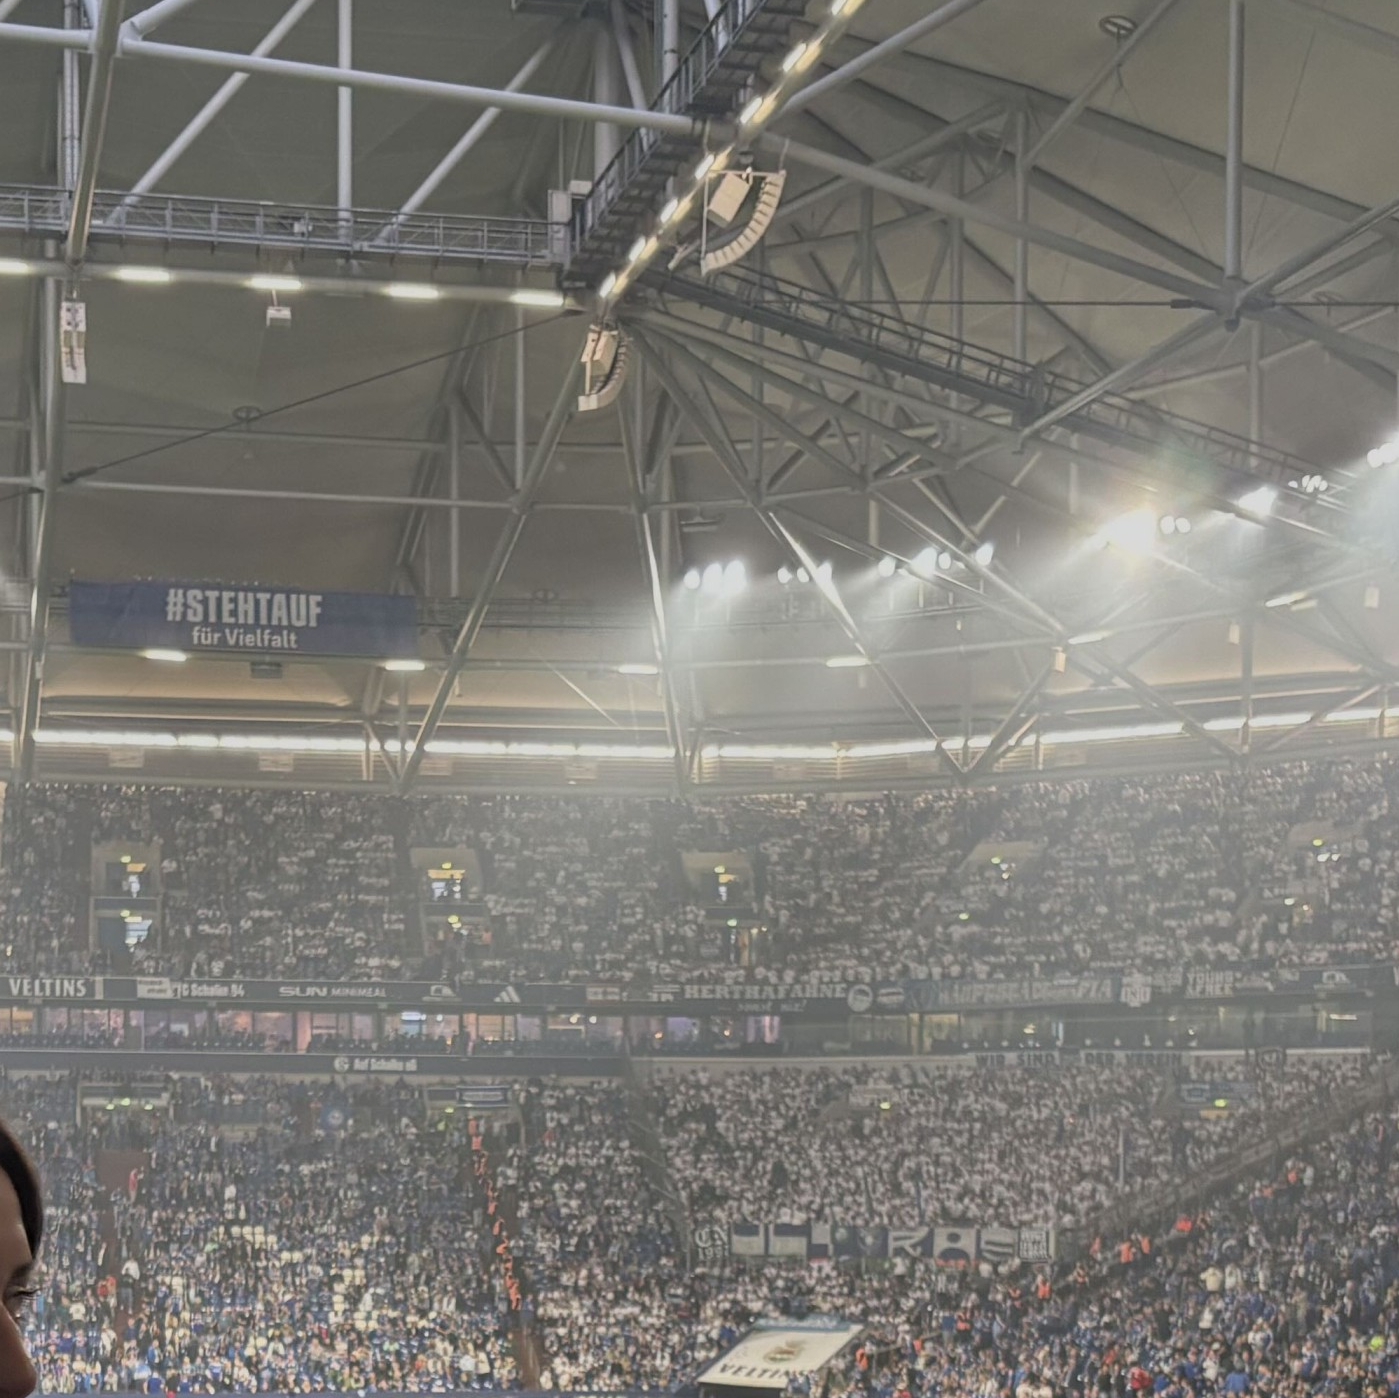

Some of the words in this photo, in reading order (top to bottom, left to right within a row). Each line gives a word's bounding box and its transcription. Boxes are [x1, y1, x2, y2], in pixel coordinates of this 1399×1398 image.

[166, 588, 323, 628] #STEHTAUF
[192, 627, 221, 645] für
[224, 628, 299, 649] Vielfalt
[8, 978, 87, 997] VELTINS
[279, 986, 327, 997] SUN
